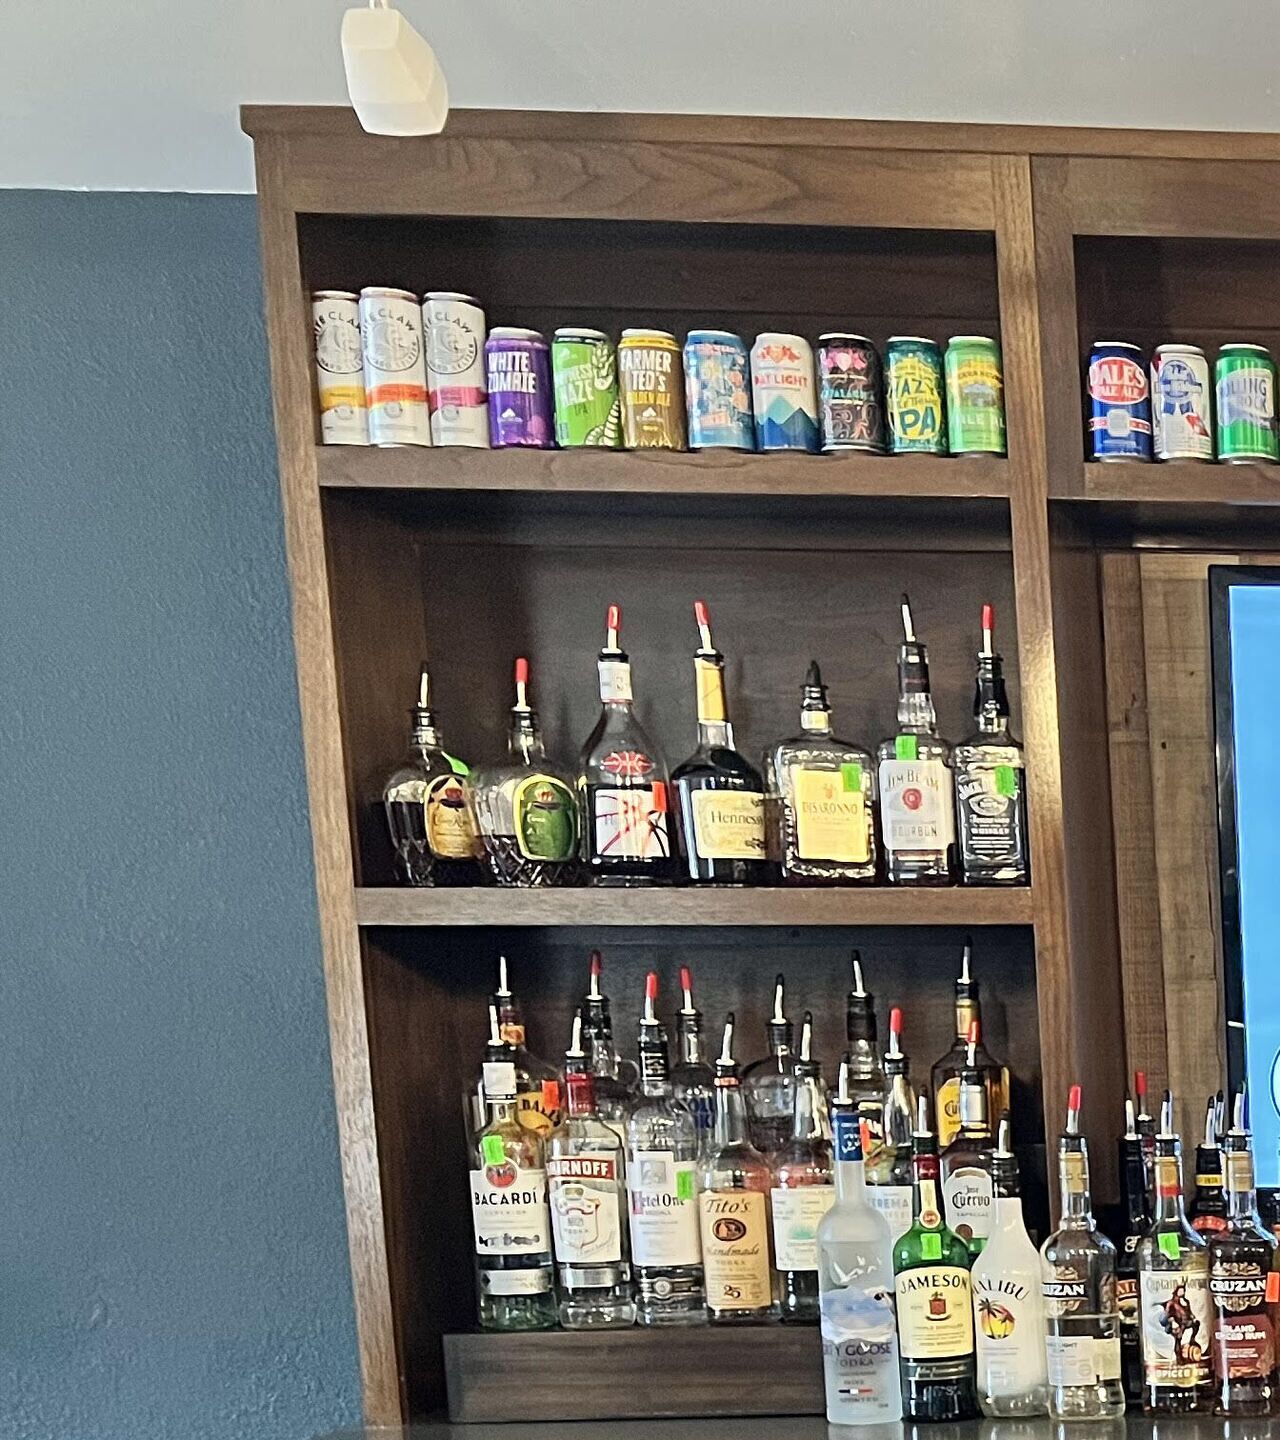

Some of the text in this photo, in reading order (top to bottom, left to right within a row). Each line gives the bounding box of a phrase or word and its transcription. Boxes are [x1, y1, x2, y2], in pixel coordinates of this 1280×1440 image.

[378, 308, 415, 332] CLAW
[436, 311, 472, 334] CLAW
[488, 352, 530, 372] WHITE
[620, 350, 672, 373] FARMER
[488, 372, 536, 393] ZOMBIE
[631, 370, 666, 392] TED'S
[474, 1186, 538, 1206] BACARDÍ
[705, 1198, 751, 1214] Tito's
[952, 1191, 990, 1209] Cuervo
[723, 1284, 741, 1299] 25
[900, 1274, 969, 1294] JAMESON
[1209, 1279, 1267, 1293] CRUZAN
[1244, 1331, 1267, 1340] RUM
[845, 1343, 892, 1356] GOOSE
